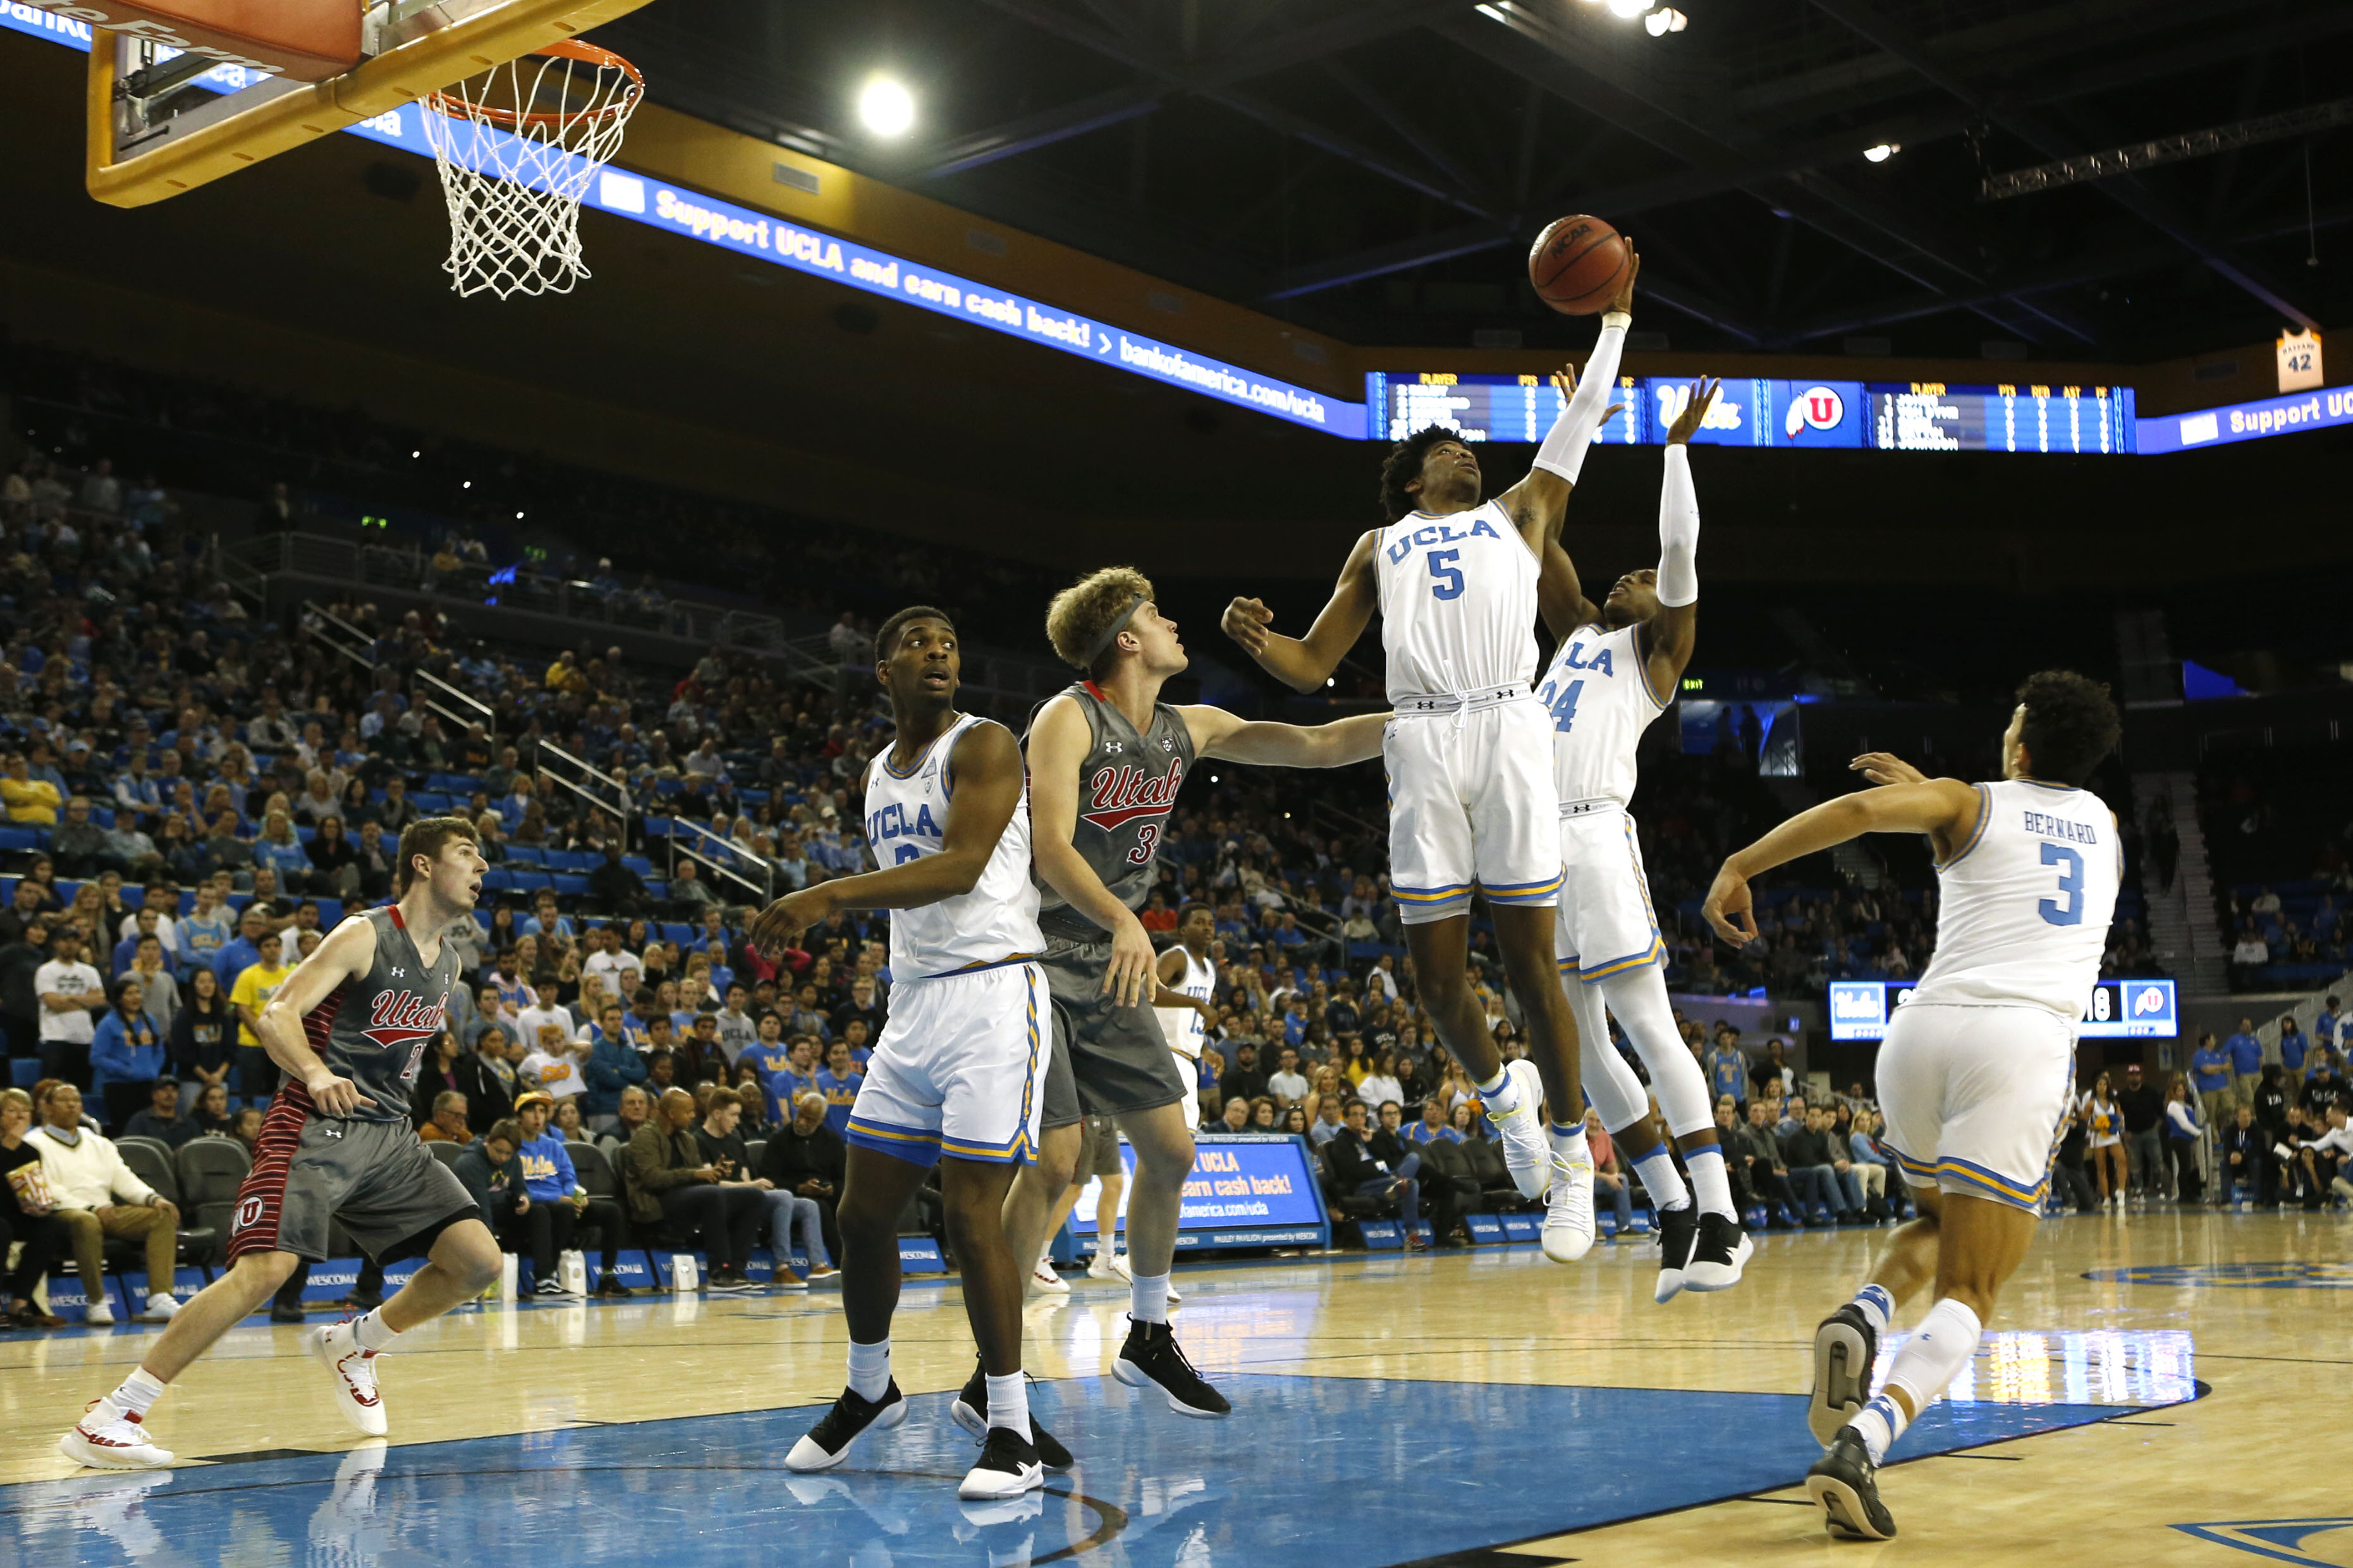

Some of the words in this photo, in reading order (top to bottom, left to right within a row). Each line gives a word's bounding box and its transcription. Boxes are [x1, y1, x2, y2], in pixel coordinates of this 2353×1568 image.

[95, 20, 284, 73] Farm
[656, 189, 769, 249] Support
[776, 226, 845, 272] UCLA
[850, 257, 898, 288] and
[904, 274, 961, 307] earn
[965, 293, 1022, 326] cash
[1027, 305, 1091, 347] back!
[1120, 335, 1326, 423] bankofamerica.com/ucla
[1419, 373, 1458, 386] PLAYER
[1519, 375, 1539, 387] PTS
[2288, 353, 2312, 373] 42
[1809, 397, 1835, 422] U
[2230, 397, 2321, 434] Support
[1387, 520, 1501, 566] UCLA
[1427, 548, 1465, 600] 5
[1682, 678, 1704, 691] EXIT
[1091, 757, 1182, 810] Utah
[867, 802, 943, 848] UCLA
[2024, 810, 2098, 845] BERNARD
[2038, 841, 2085, 927] 3
[371, 988, 449, 1029] Utah
[722, 1028, 752, 1042] UCLA
[1199, 1152, 1241, 1172] UCLA
[1214, 1176, 1250, 1196] cash
[1249, 1174, 1293, 1195] back!
[243, 1201, 261, 1224] U
